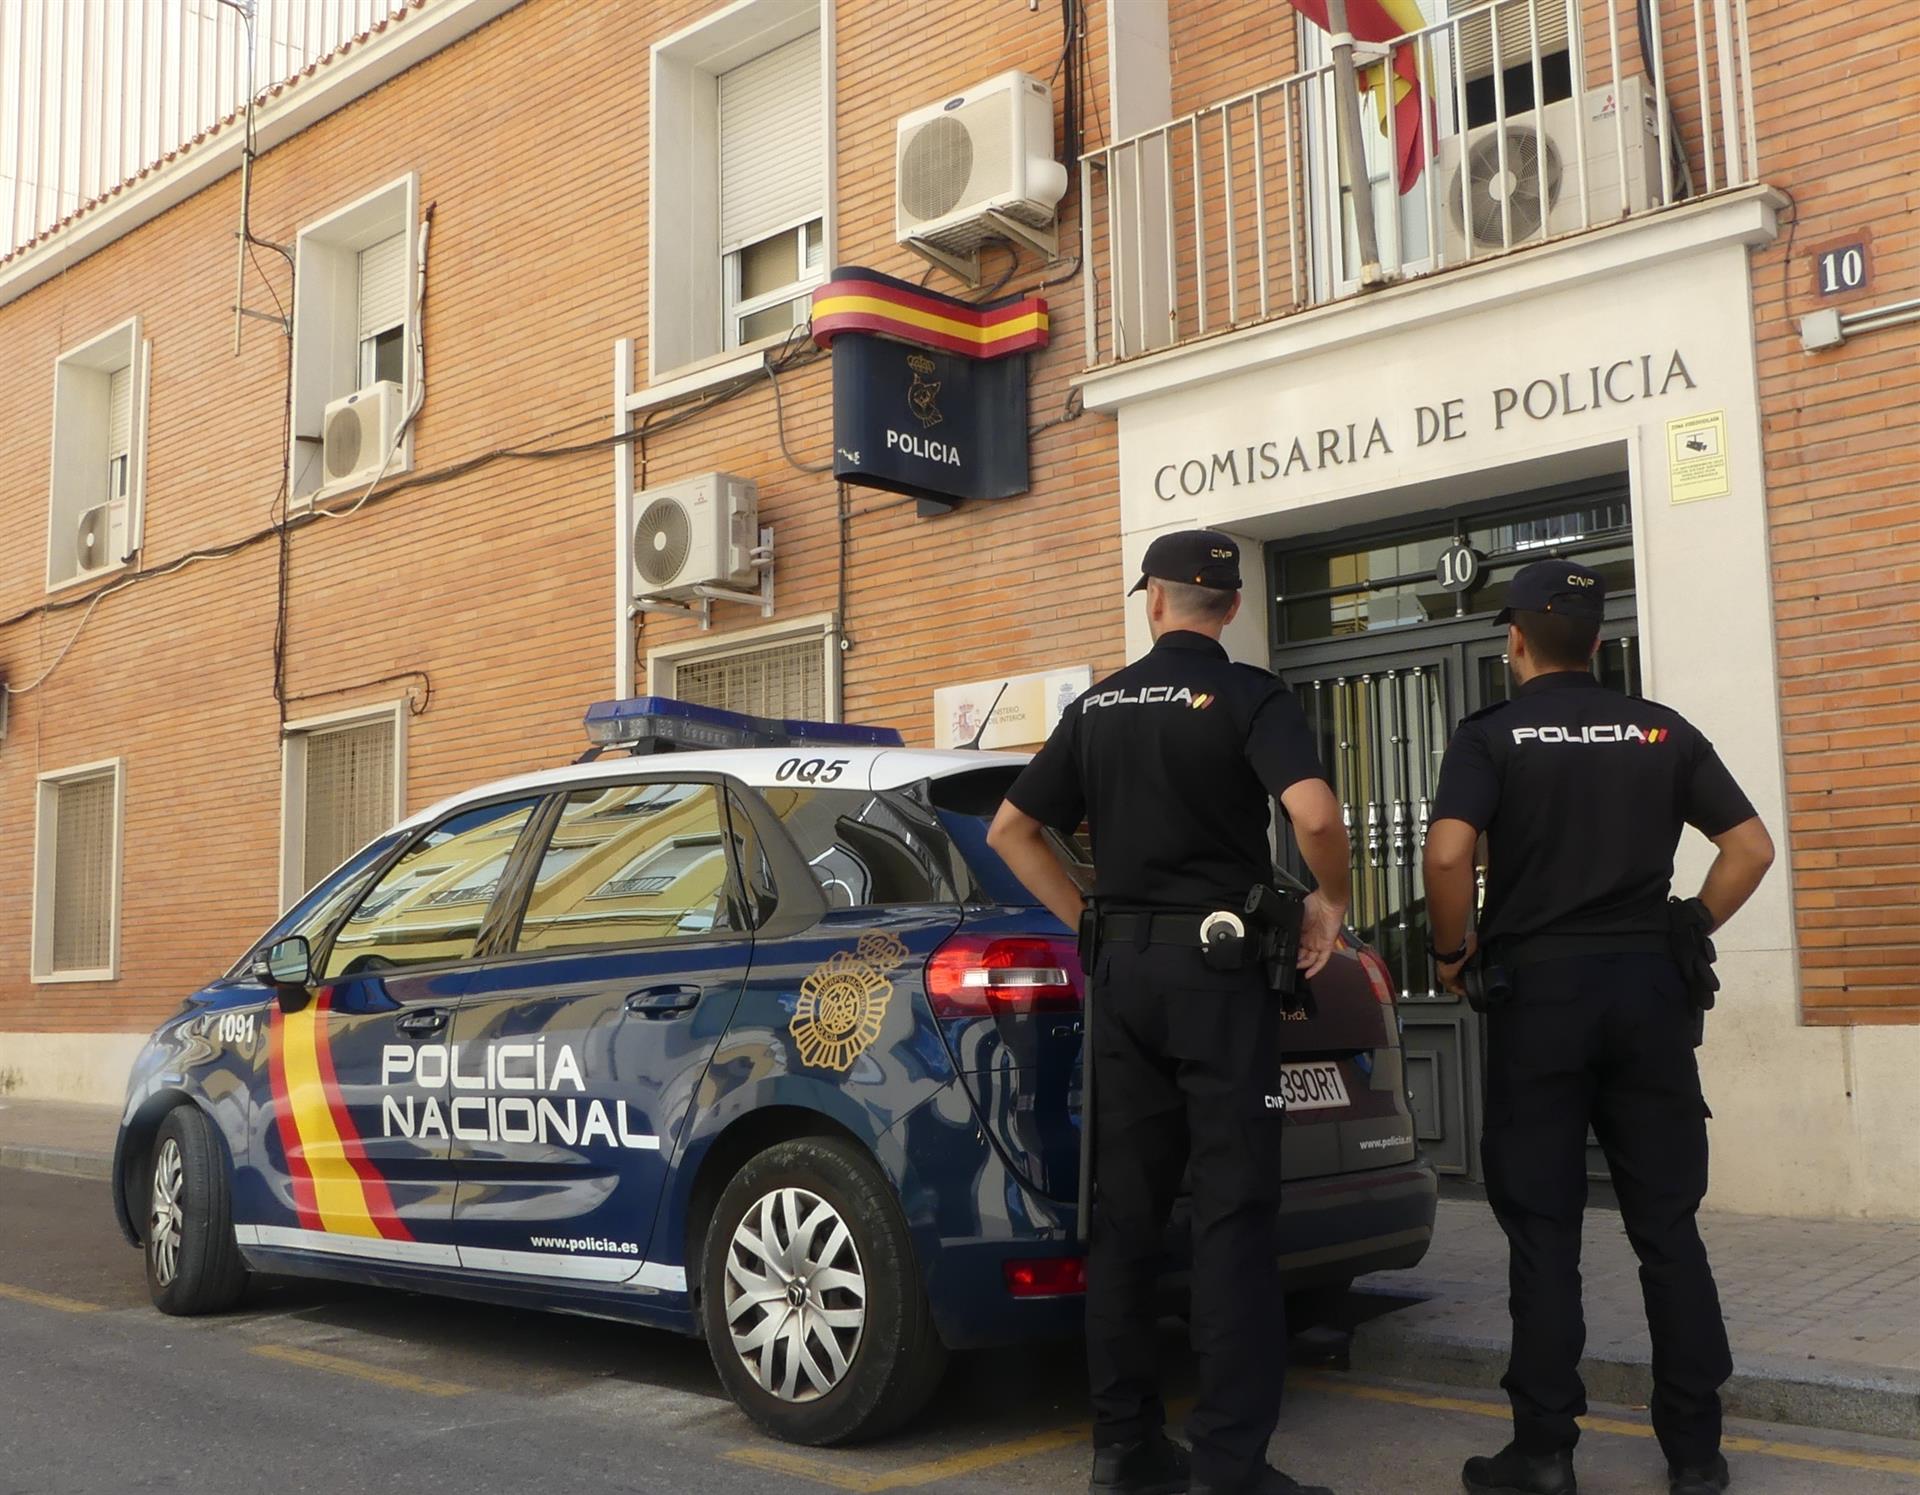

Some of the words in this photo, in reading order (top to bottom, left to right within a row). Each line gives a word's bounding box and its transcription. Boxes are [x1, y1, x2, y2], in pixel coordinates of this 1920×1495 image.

[1822, 249, 1863, 292] 10
[1154, 417, 1394, 501] COMISARIA
[1415, 399, 1467, 447] DE
[1492, 349, 1697, 430] POLICIA
[886, 429, 961, 467] POLICIA
[1210, 548, 1233, 559] CNP
[1440, 548, 1473, 586] 10
[1567, 574, 1595, 588] CNP
[1082, 686, 1193, 714] POLICIA
[1512, 724, 1646, 745] POLICIA
[218, 1014, 254, 1043] 1091
[382, 1036, 586, 1092] POLICÍA
[1264, 1094, 1285, 1109] CNP
[381, 1095, 661, 1150] NACIONAL
[530, 1235, 639, 1254] www.policia.es
